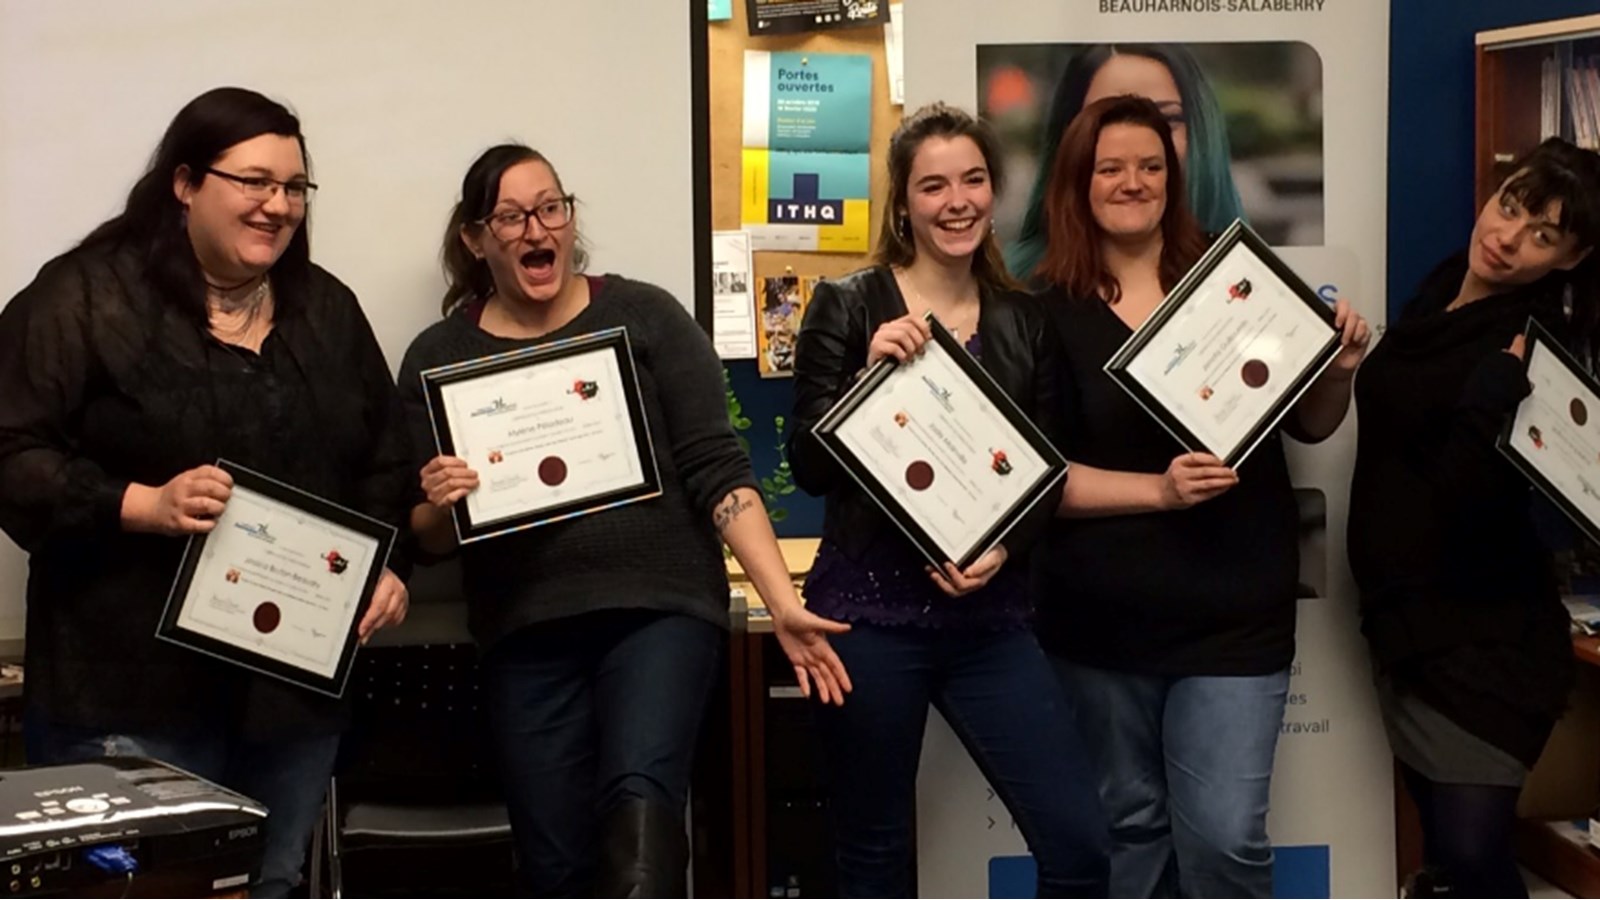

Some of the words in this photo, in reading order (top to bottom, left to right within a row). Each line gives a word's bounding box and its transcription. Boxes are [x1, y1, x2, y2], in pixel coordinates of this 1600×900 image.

[1099, 0, 1325, 13] BEAUHARNOIS-SALABERRY
[778, 68, 819, 81] Portes
[777, 82, 834, 93] ouvertes
[777, 204, 835, 219] ITHQ
